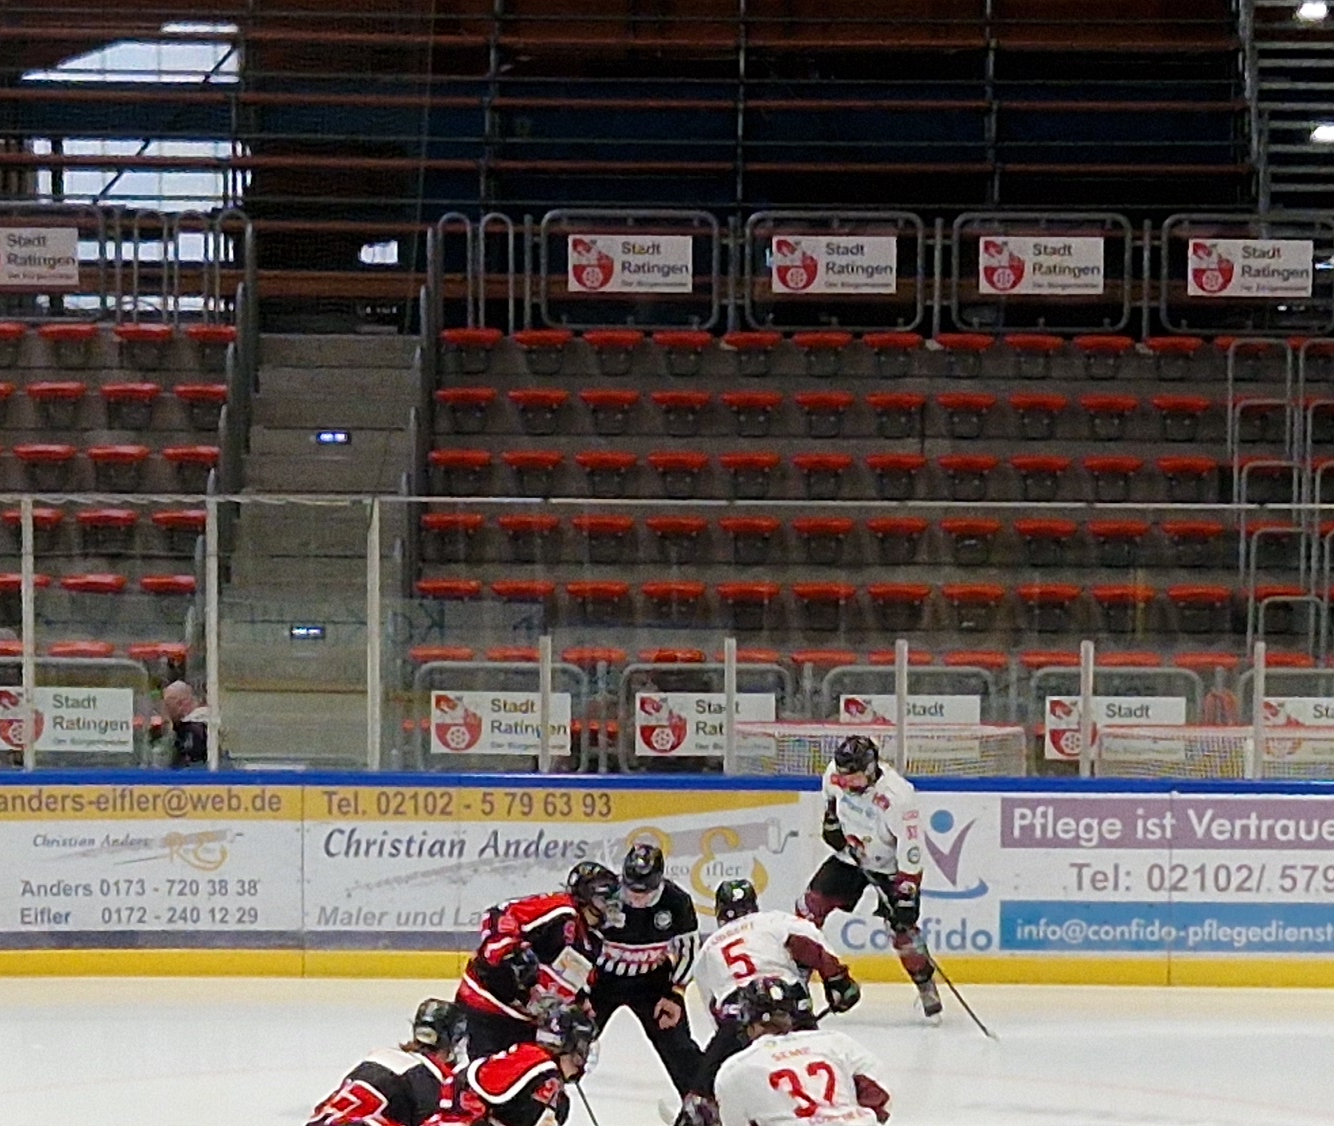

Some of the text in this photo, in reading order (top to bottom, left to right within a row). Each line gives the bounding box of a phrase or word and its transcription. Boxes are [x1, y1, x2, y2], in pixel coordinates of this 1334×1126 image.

[621, 241, 661, 255] Stadt
[825, 242, 865, 256] Stadt
[1032, 243, 1073, 257] Stadt
[1241, 245, 1282, 259] Stadt
[621, 261, 689, 278] Ratingen
[825, 261, 894, 279] Ratingen
[1032, 263, 1101, 281] Ratingen
[1241, 265, 1310, 283] Ratingen
[52, 694, 97, 711] Stadt
[491, 698, 536, 715] Stadt
[695, 699, 740, 716] Stat
[1105, 702, 1152, 719] Stadt
[52, 715, 130, 736] Ratingen
[323, 790, 366, 817] Tel.
[376, 791, 453, 817] 02102
[482, 791, 495, 817] 5
[507, 792, 533, 818] 79
[543, 792, 573, 818] 63
[582, 792, 612, 818] 93
[1012, 807, 1123, 847] Pflege
[1136, 808, 1177, 840] ist
[33, 833, 95, 849] Christian
[324, 827, 589, 860] Christian Anders
[1070, 863, 1131, 892] Tel:
[1146, 864, 1266, 894] 02102/
[21, 880, 93, 897] Anders
[100, 880, 145, 897] 0173
[167, 880, 199, 896] 720
[207, 880, 228, 896] 38
[236, 880, 258, 896] 38
[20, 907, 71, 925] Eifler
[101, 907, 147, 924] 0172
[168, 907, 199, 924] 240
[209, 907, 229, 924] 12
[236, 907, 258, 924] 29
[317, 906, 388, 927] Maler
[398, 906, 445, 927] und
[841, 919, 993, 951] Cofido
[722, 936, 756, 980] 5
[769, 1061, 836, 1118] 32
